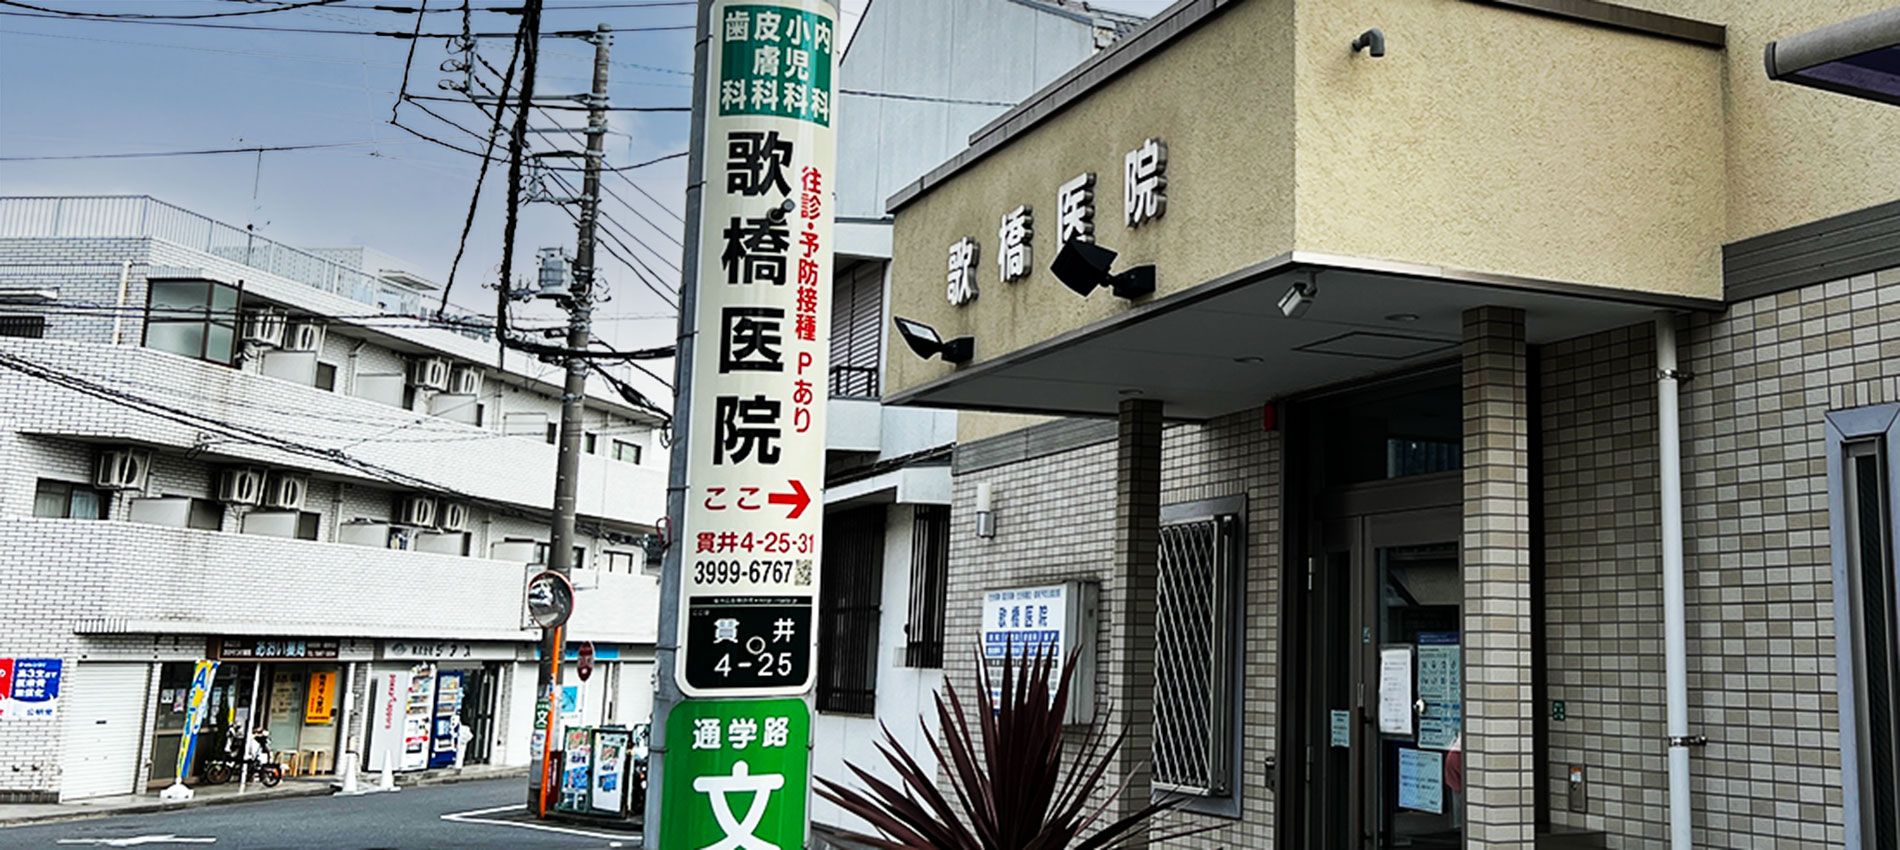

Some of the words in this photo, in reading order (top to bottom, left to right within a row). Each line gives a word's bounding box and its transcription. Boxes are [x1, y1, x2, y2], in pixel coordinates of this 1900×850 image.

[721, 12, 750, 111] 歯科
[751, 11, 782, 112] 皮膚科
[783, 15, 811, 116] 小児科
[811, 21, 833, 122] 内科
[947, 137, 1167, 306] 歌橋医院
[713, 131, 794, 466] 歌橋医院
[696, 532, 815, 553] 貫井4-25-31
[704, 487, 761, 510] ここ
[694, 560, 793, 584] 3999-6767
[714, 653, 792, 677] 4-25
[692, 717, 789, 749] 通学路
[693, 760, 785, 850] 文
